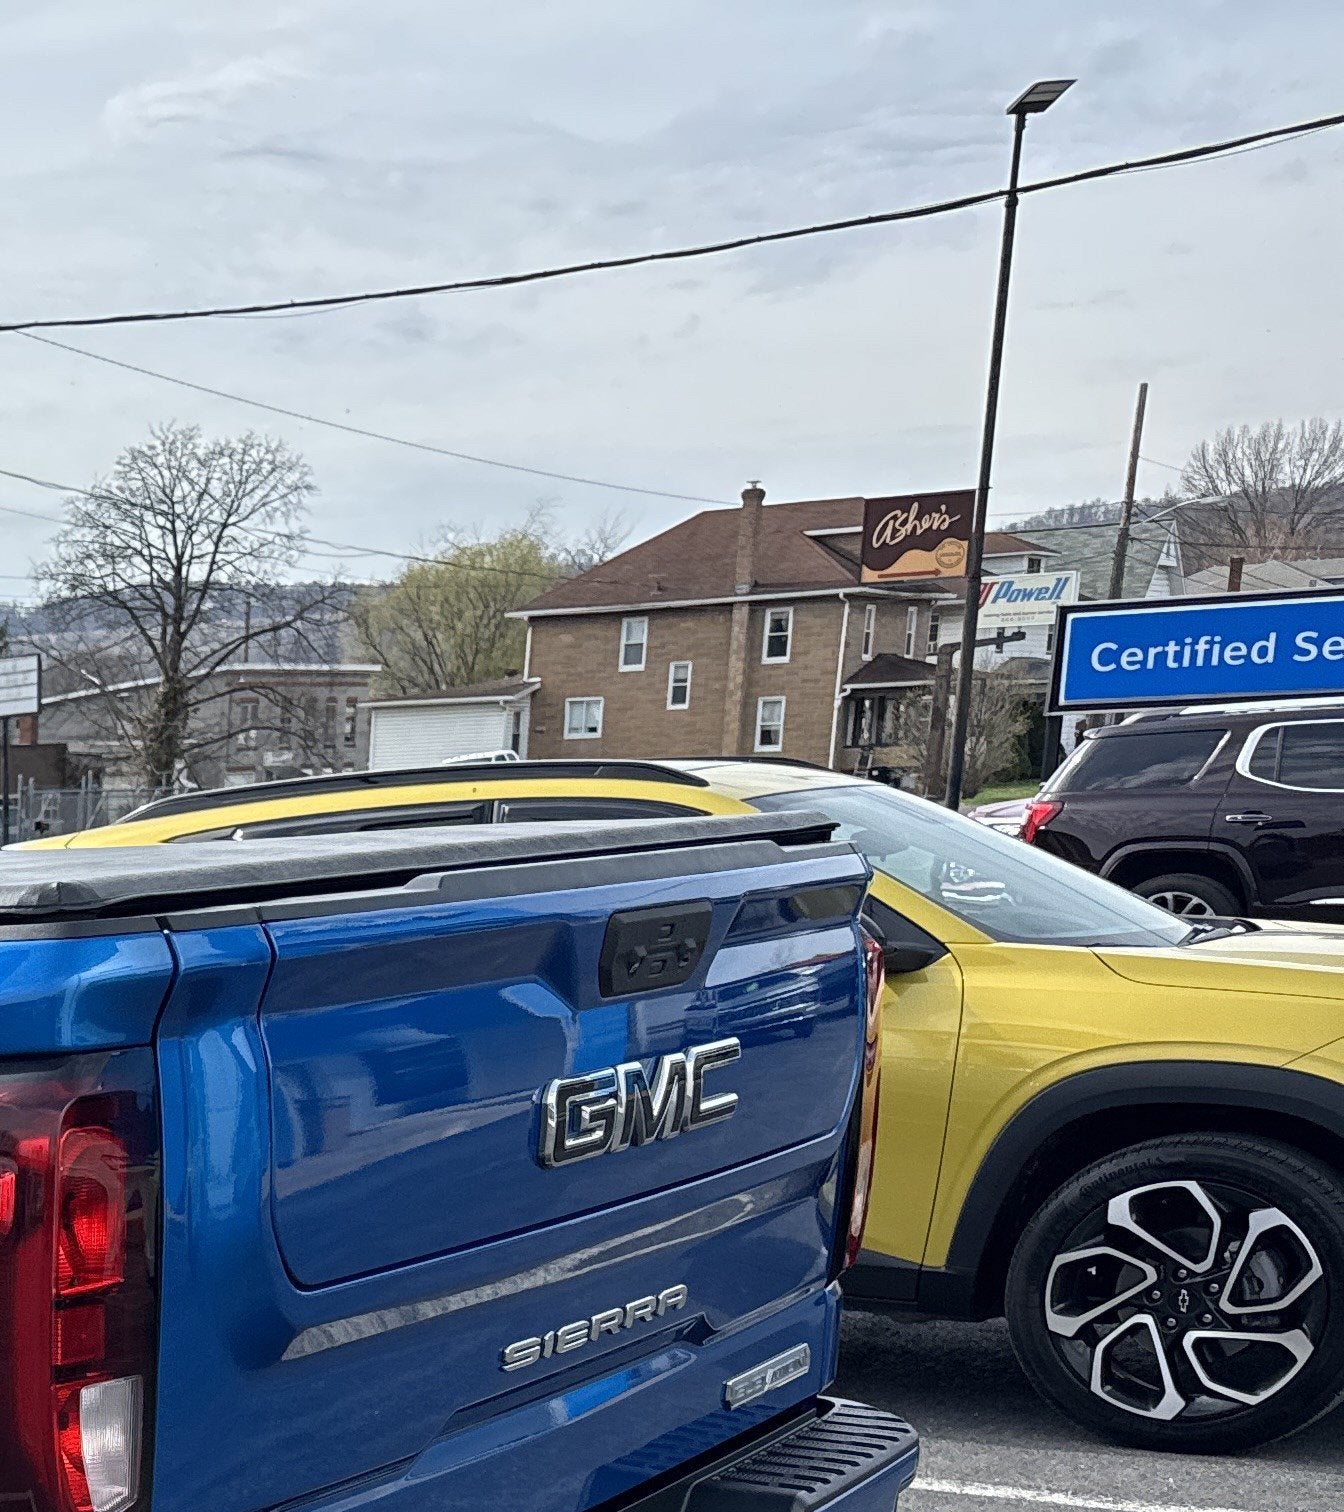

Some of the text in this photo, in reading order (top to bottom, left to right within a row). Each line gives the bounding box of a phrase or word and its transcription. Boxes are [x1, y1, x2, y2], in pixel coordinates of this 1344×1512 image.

[991, 576, 1070, 604] Powell
[1090, 630, 1344, 673] Certified Se
[538, 1036, 742, 1169] GMC
[500, 1283, 689, 1372] SIERRA
